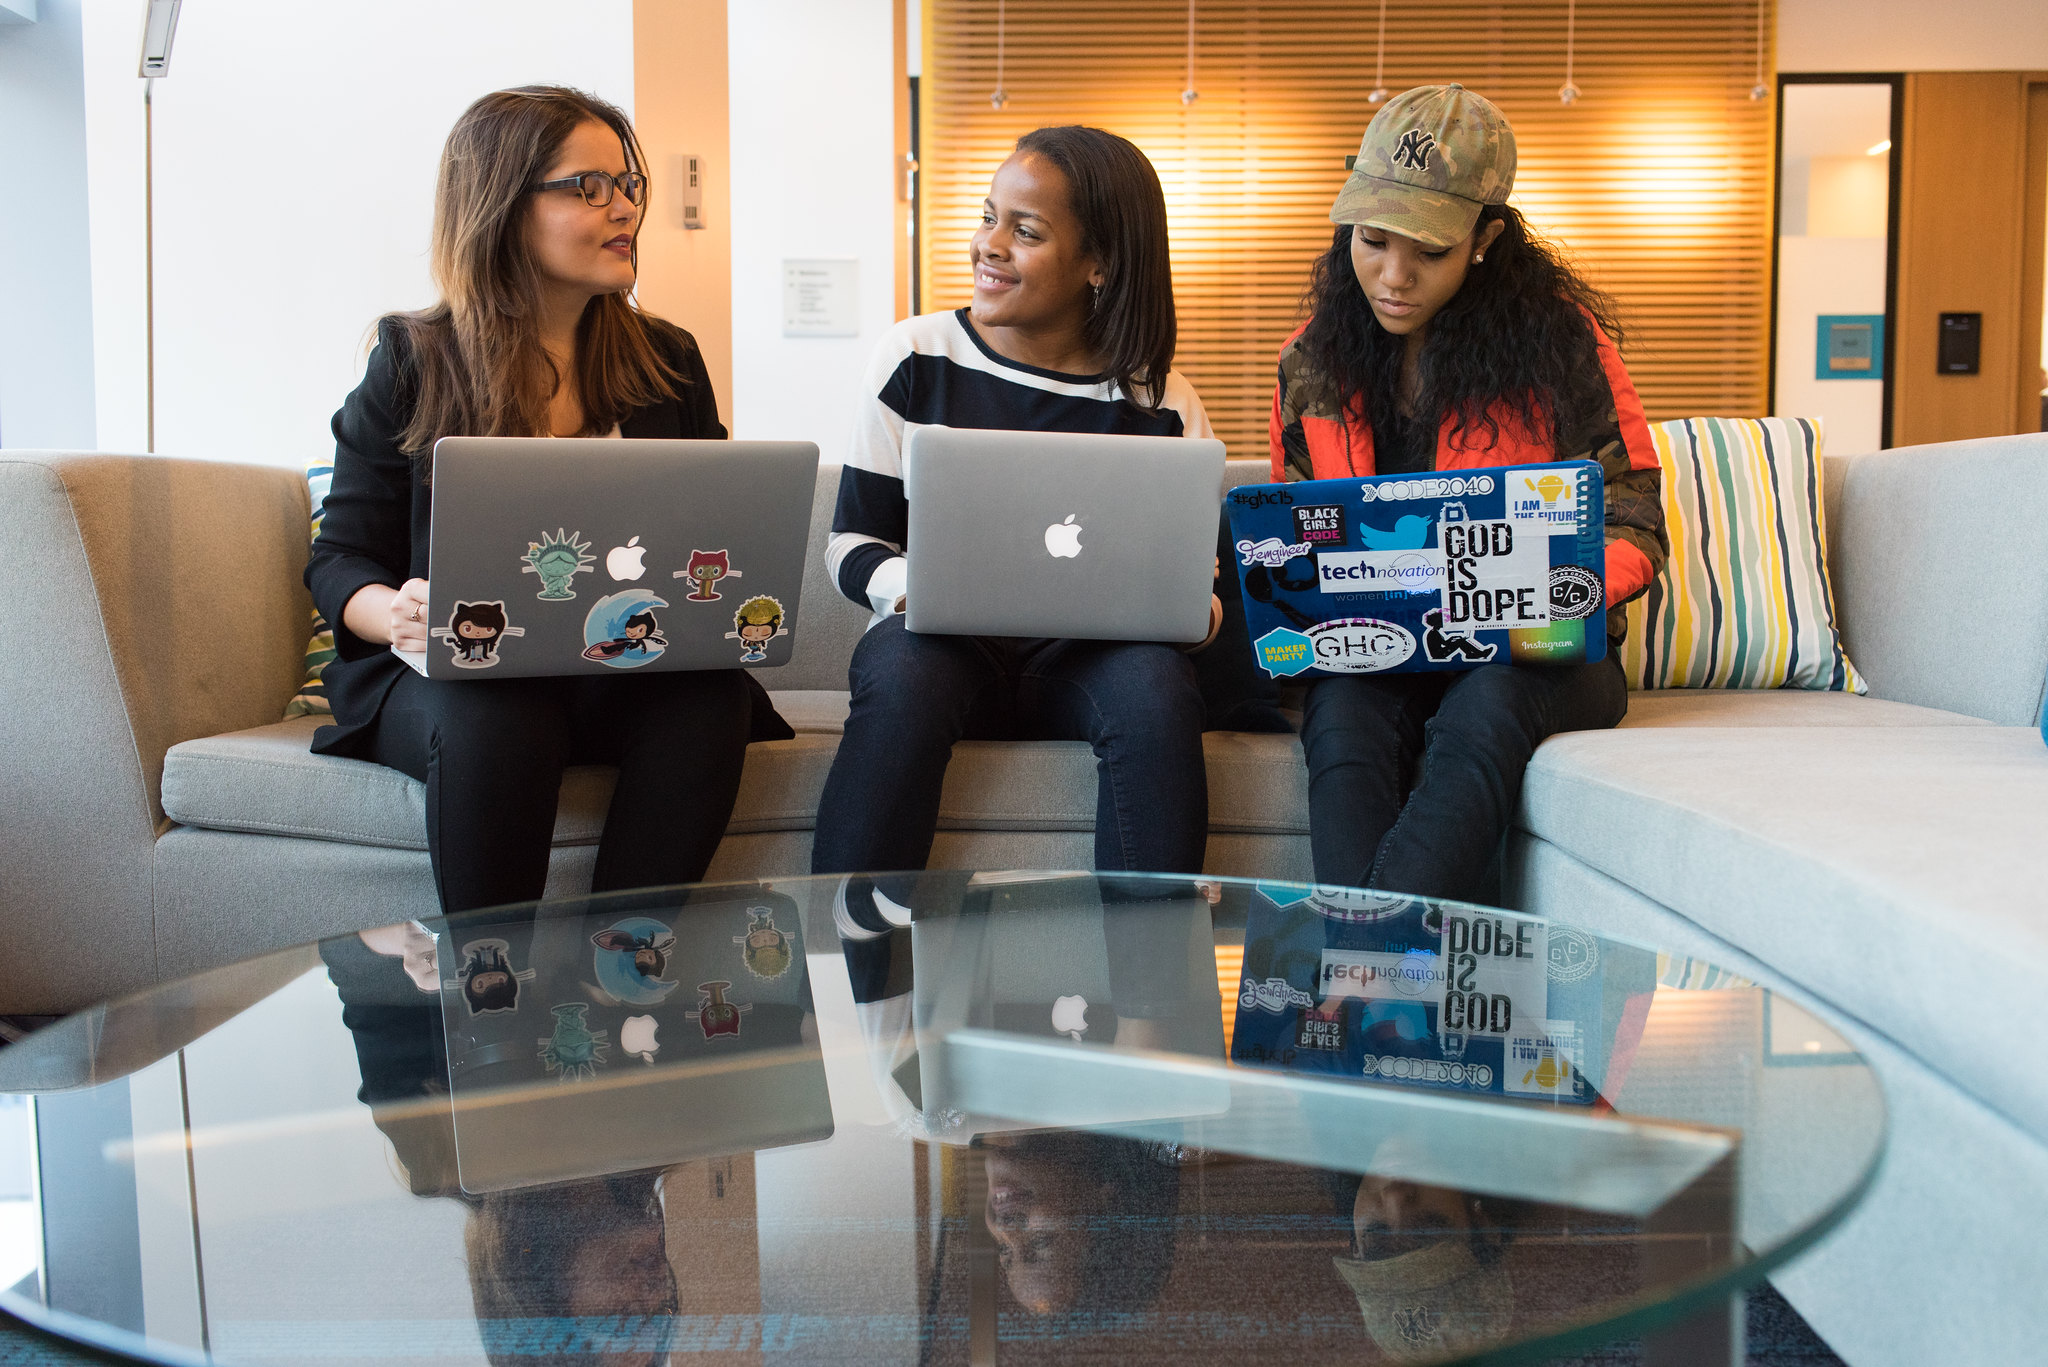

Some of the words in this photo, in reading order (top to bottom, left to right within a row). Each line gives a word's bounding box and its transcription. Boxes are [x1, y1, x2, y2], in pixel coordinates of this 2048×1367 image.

[1391, 128, 1438, 171] NY
[1378, 478, 1493, 500] CODE2040
[1234, 491, 1294, 509] #ghc15
[1514, 501, 1518, 511] I
[1522, 500, 1540, 511] AM
[1298, 507, 1339, 520] BLACK
[1303, 519, 1338, 531] GIRLS
[1303, 530, 1341, 541] CODE
[1445, 523, 1513, 558] GOD
[1238, 539, 1309, 565] Femgineer
[1447, 557, 1478, 591] IS
[1449, 587, 1546, 623] DOPE.
[1264, 643, 1308, 655] MAKER
[1521, 640, 1574, 652] Instagram
[1267, 653, 1304, 663] PARTY
